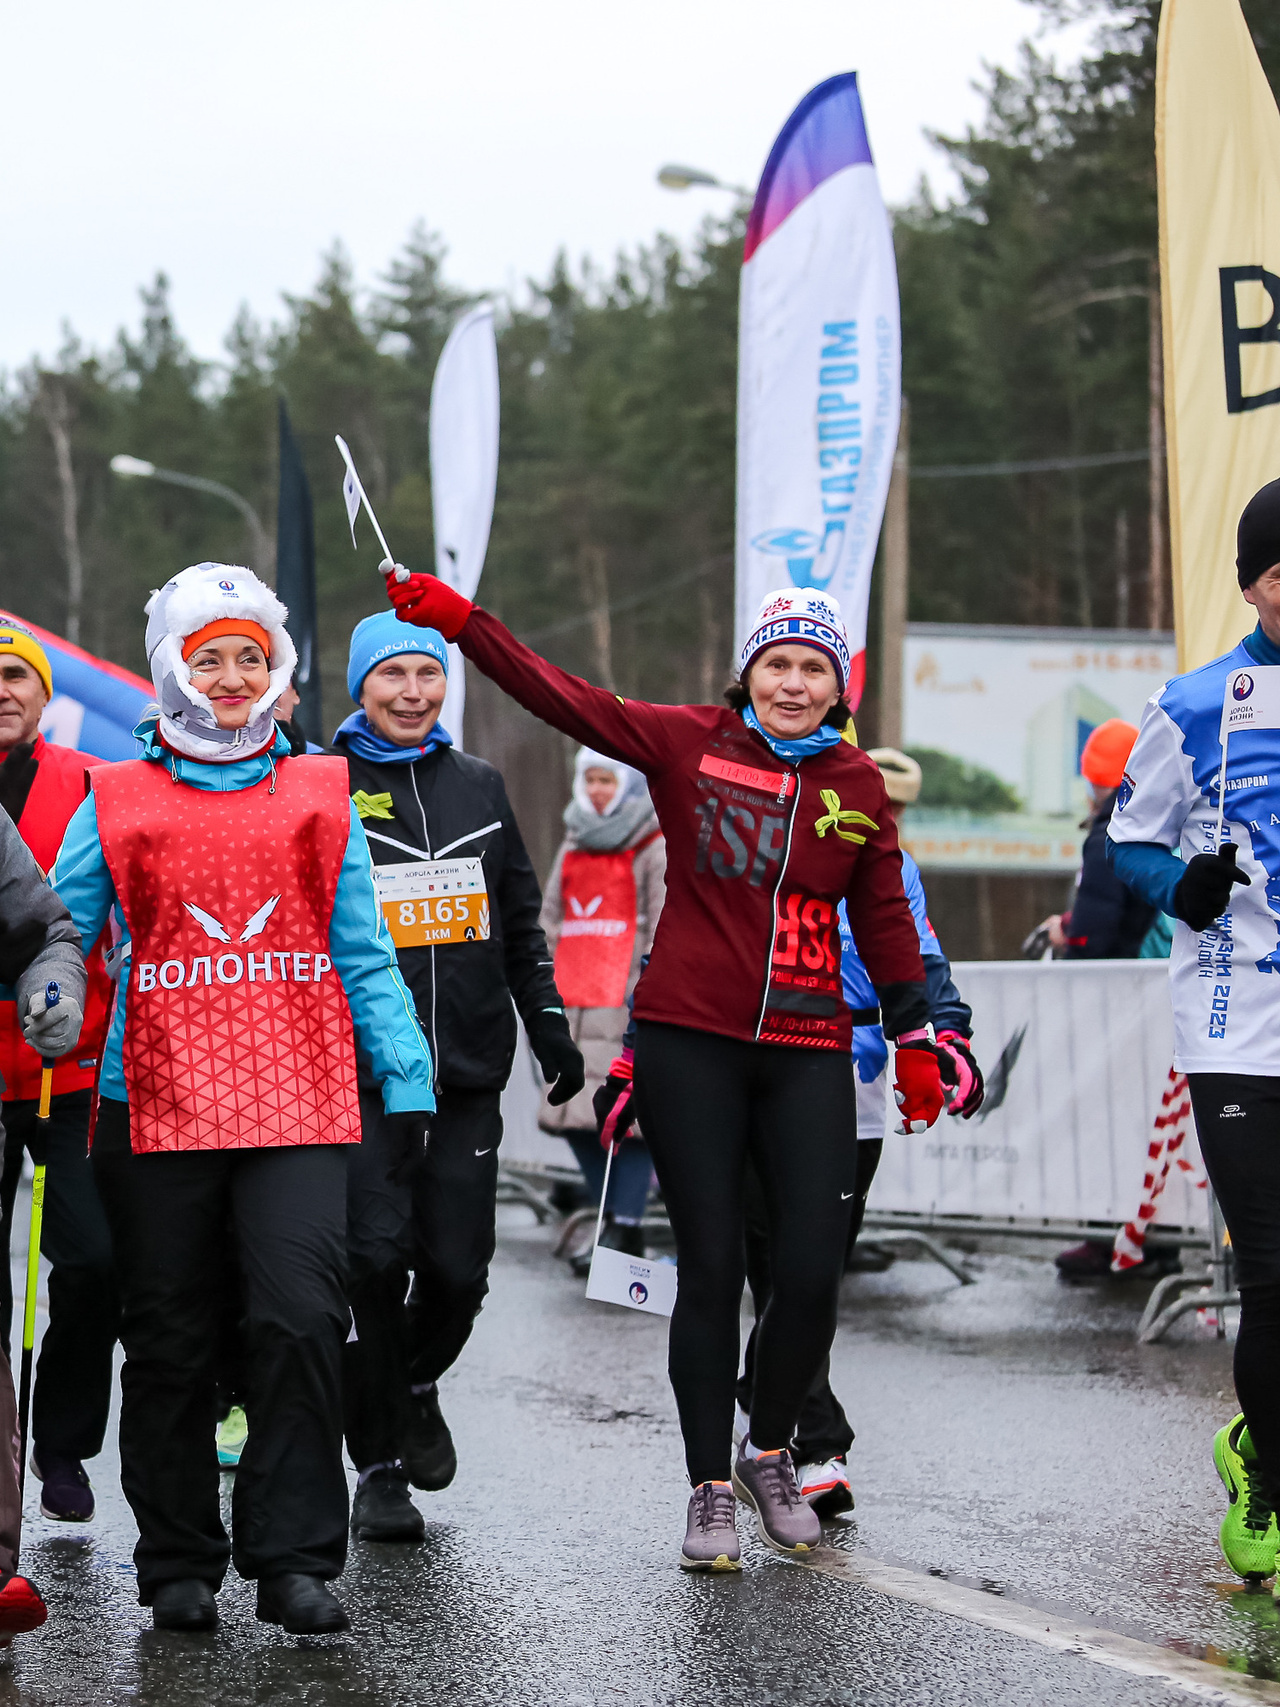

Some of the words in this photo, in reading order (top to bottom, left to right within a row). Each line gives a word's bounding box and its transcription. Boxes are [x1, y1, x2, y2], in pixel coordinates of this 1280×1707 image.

[817, 320, 863, 515] ГАЗПРОМ
[368, 639, 419, 666] ДОРОГА
[1228, 711, 1254, 723] ЖИЗНИ
[1229, 705, 1253, 716] ДОРОГА
[776, 771, 791, 804] Reebok
[1225, 775, 1269, 791] ГАЗПРОМ
[434, 867, 460, 876] ЖИЗНИ
[398, 896, 470, 927] 8165
[138, 950, 333, 993] ВОЛОНТЕР
[1208, 984, 1230, 1039] 2023
